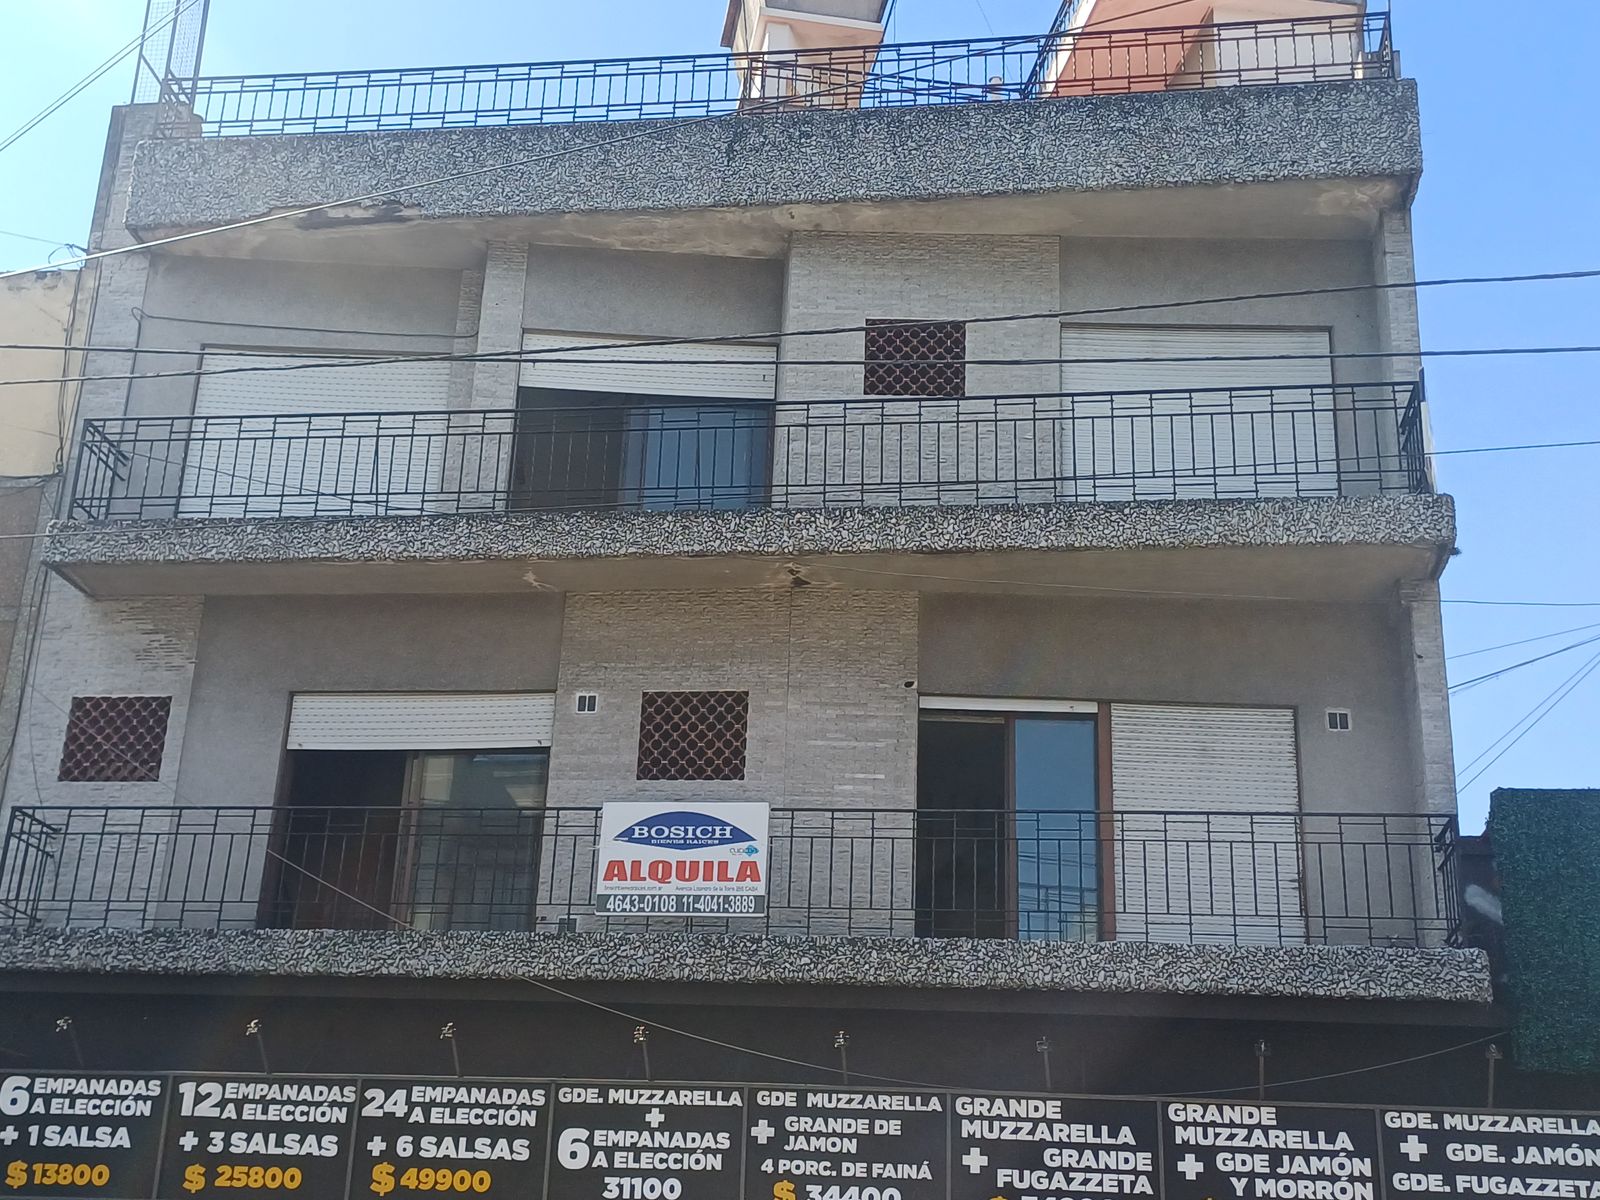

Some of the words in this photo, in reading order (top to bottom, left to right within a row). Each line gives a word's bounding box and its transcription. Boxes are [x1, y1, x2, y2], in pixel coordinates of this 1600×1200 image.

[631, 826, 733, 839] BOSICH
[602, 860, 761, 884] ALQUILA
[606, 895, 677, 912] 4643-0108
[682, 895, 755, 912] 11-4041-3889
[0, 1076, 31, 1116] 6
[33, 1078, 162, 1096] EMPANADAS
[29, 1097, 46, 1114] A
[49, 1096, 152, 1117] ELECCIÓN
[179, 1082, 223, 1117] 12
[224, 1083, 356, 1103] EMPANADAS
[361, 1088, 408, 1117] 24
[411, 1086, 545, 1106] EMPANADAS
[558, 1087, 604, 1104] GDE.
[609, 1089, 742, 1107] MUZZARELLA
[756, 1090, 797, 1107] GDE
[806, 1092, 943, 1112] MUZZARELLA
[955, 1097, 1062, 1119] GRANDE
[221, 1104, 237, 1120] A
[242, 1103, 347, 1124] ELECCIÓN
[408, 1108, 424, 1123] A
[430, 1106, 536, 1127] ELECCIÓN
[645, 1107, 665, 1128] +
[1168, 1103, 1276, 1126] GRANDE
[1384, 1111, 1439, 1129] GDE.
[1443, 1113, 1600, 1136] MUZZARELLA
[0, 1125, 19, 1146] +
[28, 1125, 40, 1146] 1
[42, 1125, 131, 1148] SALSA
[751, 1119, 775, 1145] +
[784, 1116, 870, 1135] GRANDE
[874, 1118, 902, 1136] DE
[961, 1120, 1136, 1145] MUZZARELLA
[1175, 1126, 1354, 1152] MUZZARELLA
[179, 1131, 198, 1152] +
[207, 1131, 224, 1153] 3
[229, 1132, 338, 1157] SALSAS
[366, 1135, 386, 1157] +
[396, 1136, 413, 1158] 6
[419, 1136, 530, 1161] SALSAS
[557, 1127, 590, 1170] 6
[593, 1130, 730, 1150] EMPANADAS
[783, 1135, 858, 1154] JAMON
[1400, 1135, 1428, 1162] +
[1446, 1143, 1506, 1163] GDE.
[1511, 1142, 1600, 1167] JAMÓN
[591, 1151, 608, 1168] A
[613, 1150, 723, 1171] ELECCIÓN
[761, 1159, 775, 1174] 4
[778, 1159, 837, 1177] PORC.
[841, 1161, 867, 1177] DE
[872, 1160, 932, 1180] FAINÁ
[962, 1147, 988, 1174] +
[1043, 1148, 1152, 1172] GRANDE
[1177, 1153, 1204, 1180] +
[1216, 1152, 1270, 1173] GDE
[1276, 1152, 1372, 1177] JAMÓN
[5, 1160, 29, 1189] $
[32, 1163, 110, 1187] 13800
[182, 1163, 205, 1193] $
[214, 1165, 302, 1190] 25800
[369, 1162, 395, 1197] $
[400, 1167, 491, 1193] 49900
[997, 1169, 1154, 1195] FUGAZZETA
[1392, 1172, 1451, 1193] GDE.
[602, 1176, 682, 1200] 31100
[1229, 1176, 1249, 1197] Y
[1254, 1177, 1374, 1200] MORRÓN
